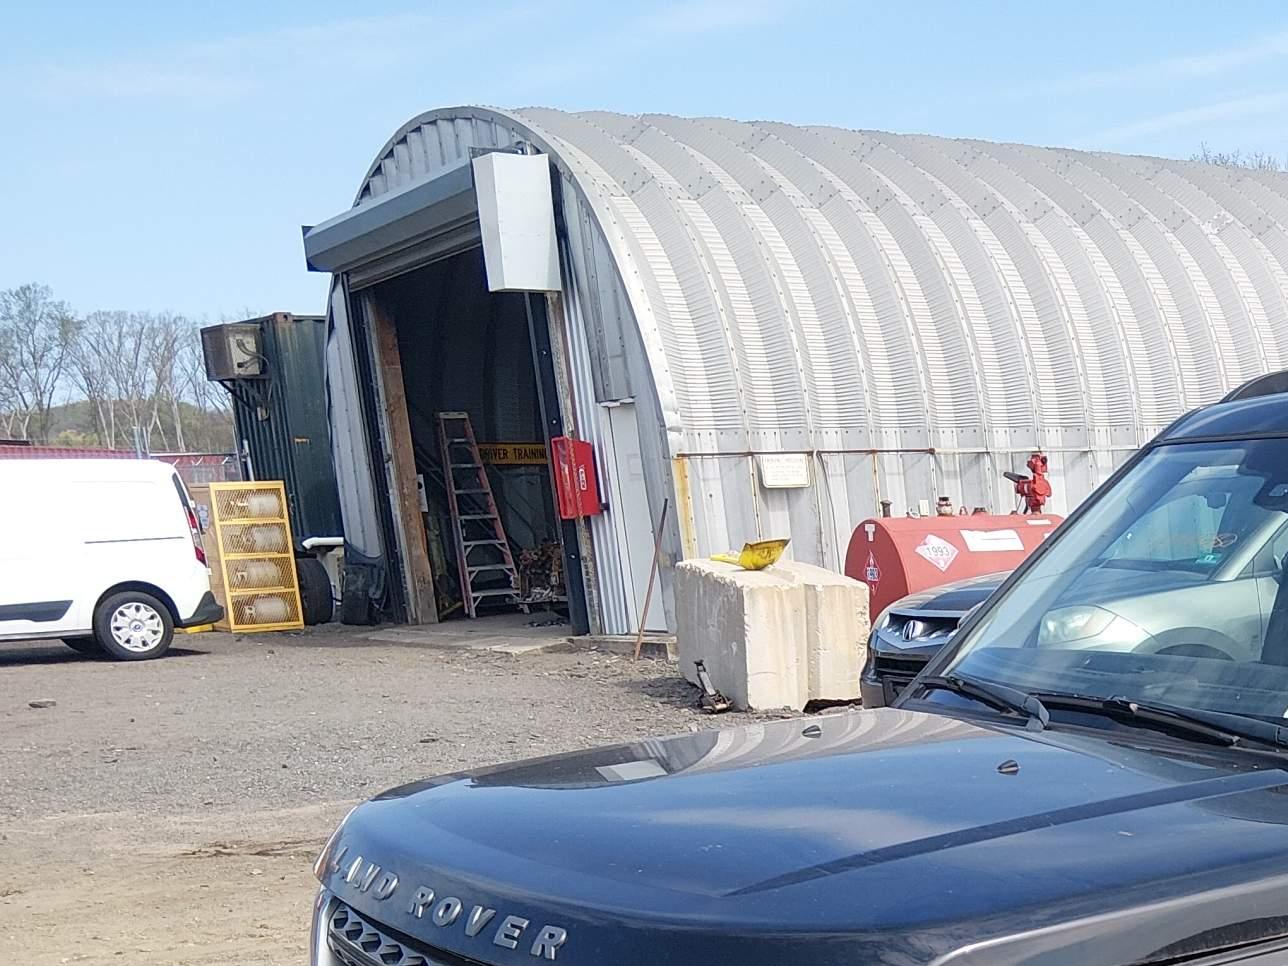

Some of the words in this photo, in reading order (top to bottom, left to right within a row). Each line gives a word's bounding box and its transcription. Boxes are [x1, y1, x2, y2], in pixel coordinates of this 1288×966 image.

[926, 546, 949, 556] 1993
[331, 846, 400, 901] LAND
[407, 884, 569, 961] ROVER
